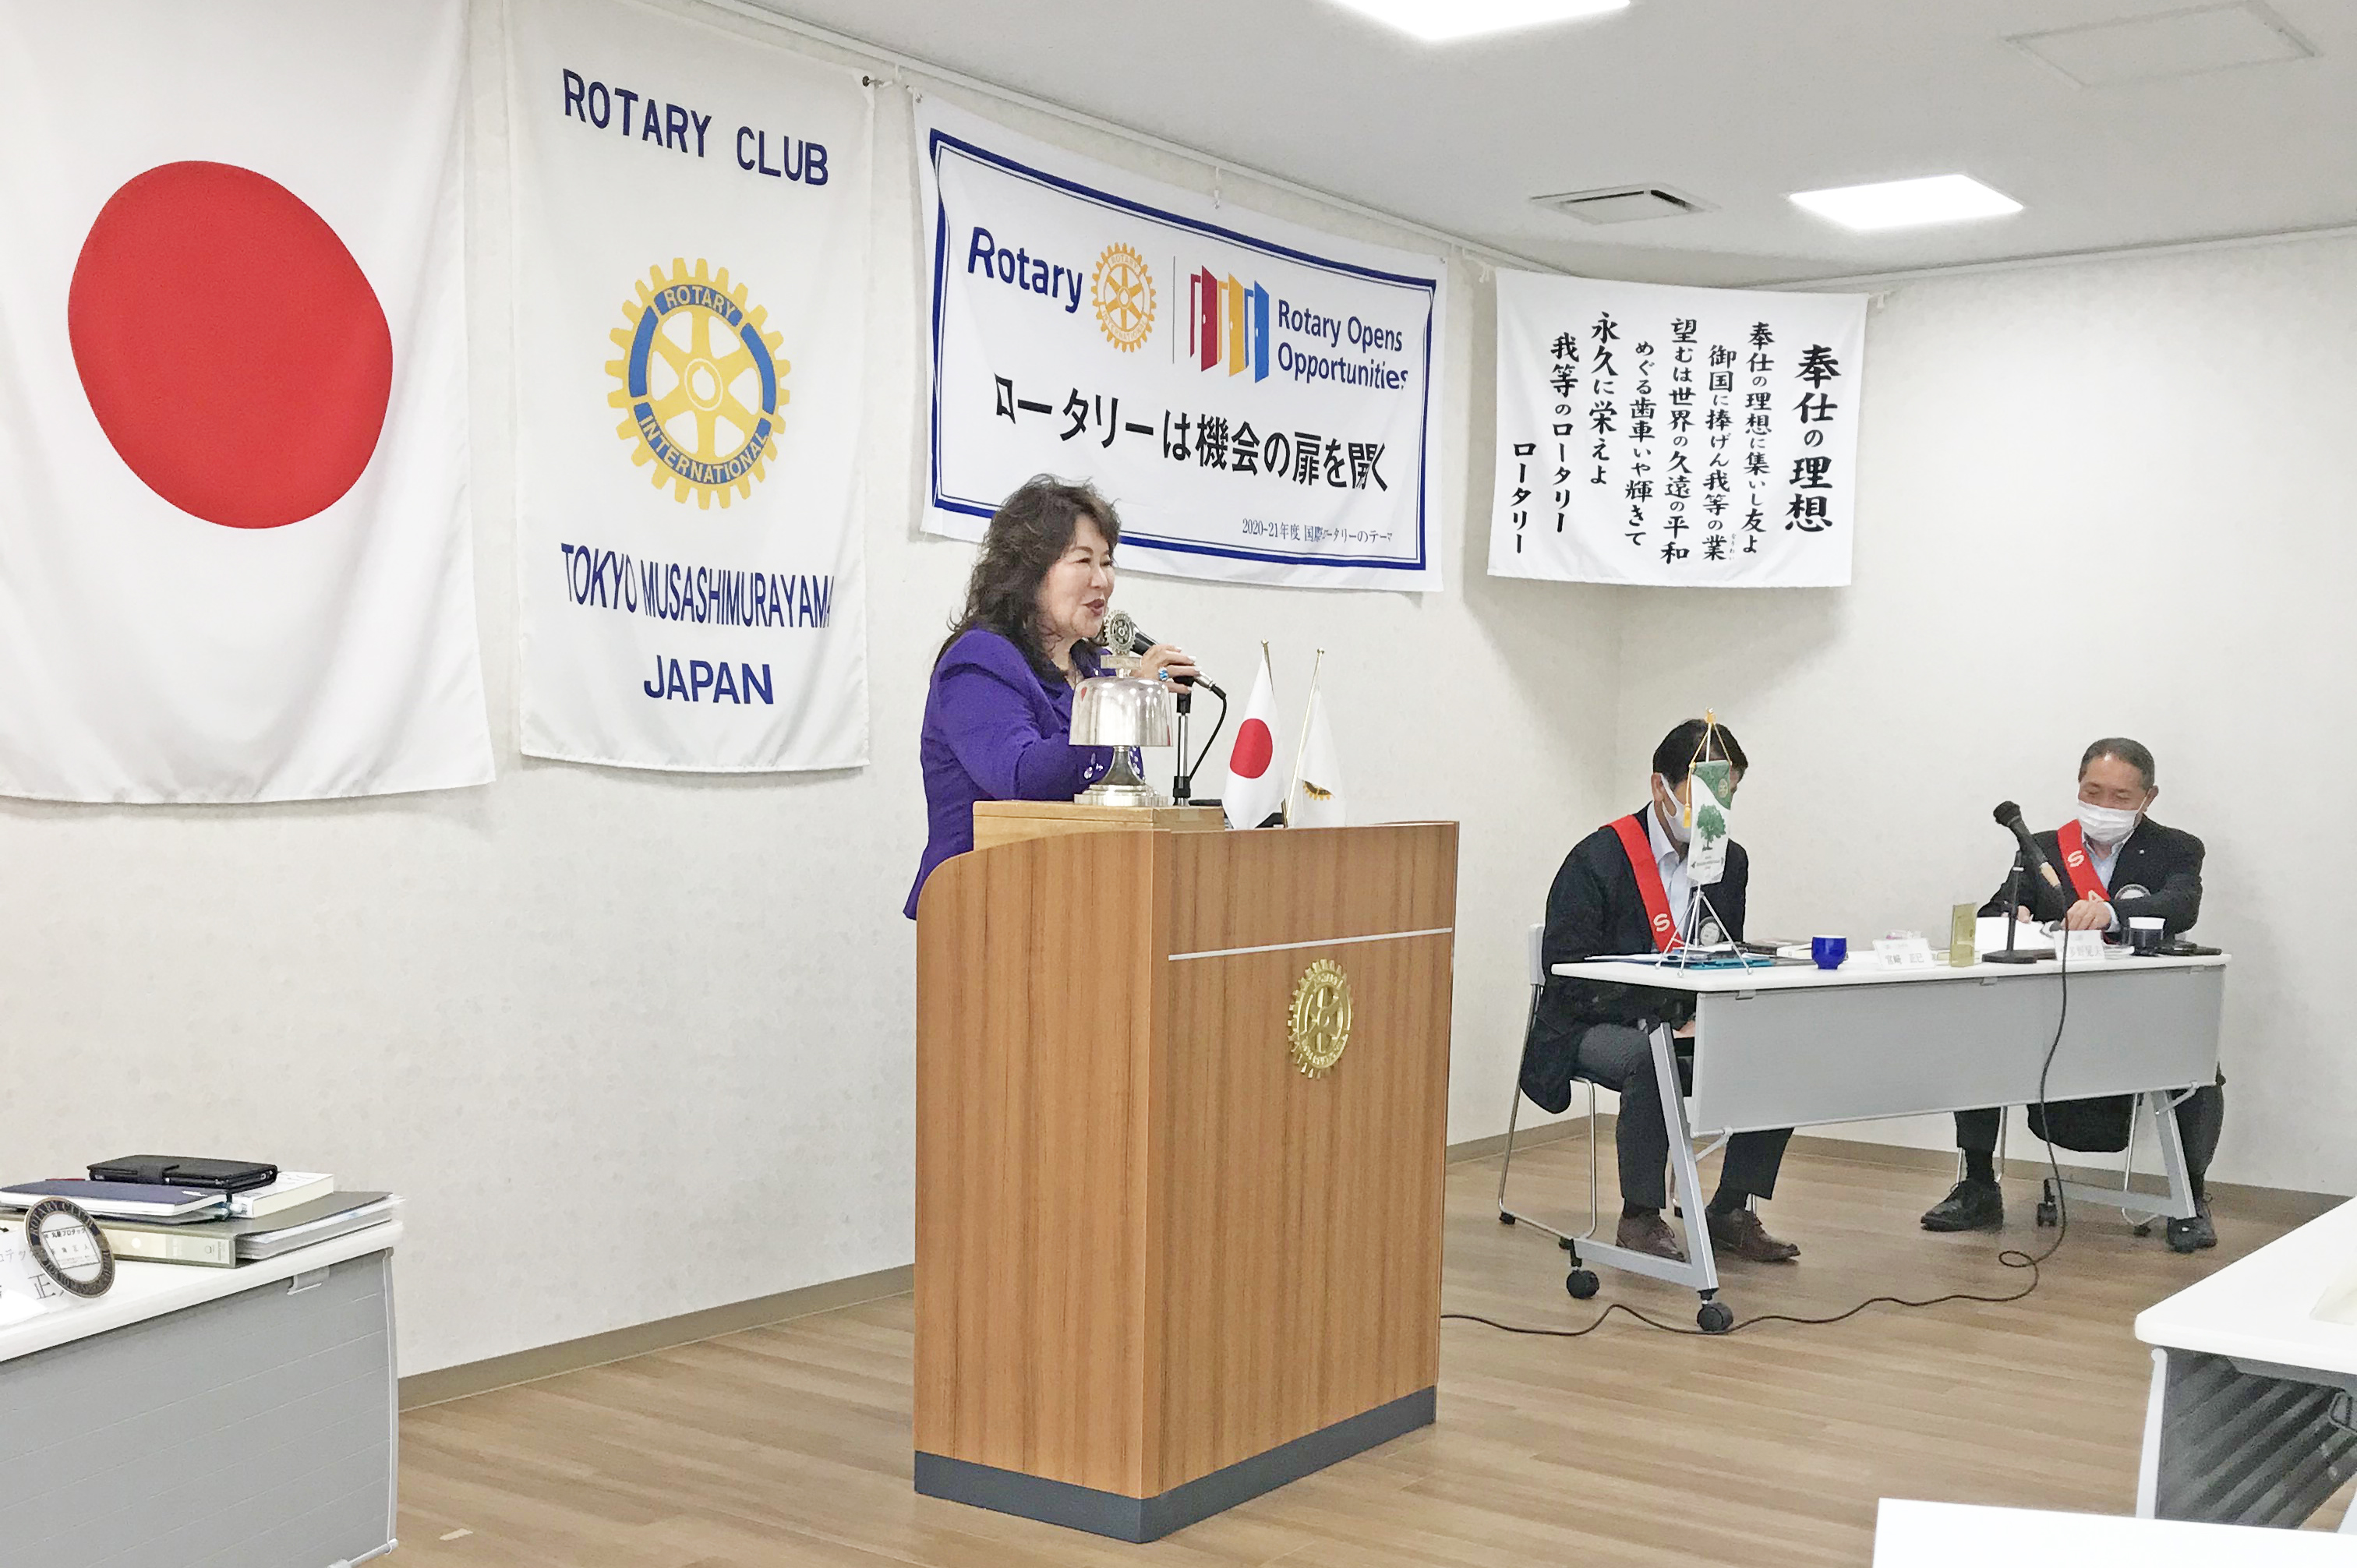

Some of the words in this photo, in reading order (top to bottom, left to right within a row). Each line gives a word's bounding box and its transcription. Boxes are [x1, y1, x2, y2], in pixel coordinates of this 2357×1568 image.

[563, 68, 712, 158] ROTARY
[736, 125, 829, 186] CLUB
[663, 285, 736, 320] ROTARY
[967, 226, 1083, 314] Rotary
[1277, 298, 1341, 348] Rotary
[1347, 316, 1403, 353] Opens
[1277, 341, 1409, 390] Opportunities
[1589, 310, 1621, 485] 永久に栄えよ
[638, 414, 769, 484] INTERNATIONAL
[995, 373, 1389, 492] ロータリーは機会の扉を開く
[1550, 331, 1580, 534] 我等のロータリー
[1625, 340, 1657, 546] めぐる歯車いや輝きて
[1660, 317, 1698, 565] 望むは世界の久遠の平和
[1702, 344, 1737, 562] 御国に捧げん我等の業
[1741, 320, 1776, 554] 奉仕の理想に集いし友よ
[1785, 343, 1843, 533] 奉仕の理想
[1242, 518, 1300, 541] 2020-21年度
[1511, 442, 1537, 554] ロータリー
[560, 542, 638, 614] TOKYO
[643, 654, 775, 705] JAPAN
